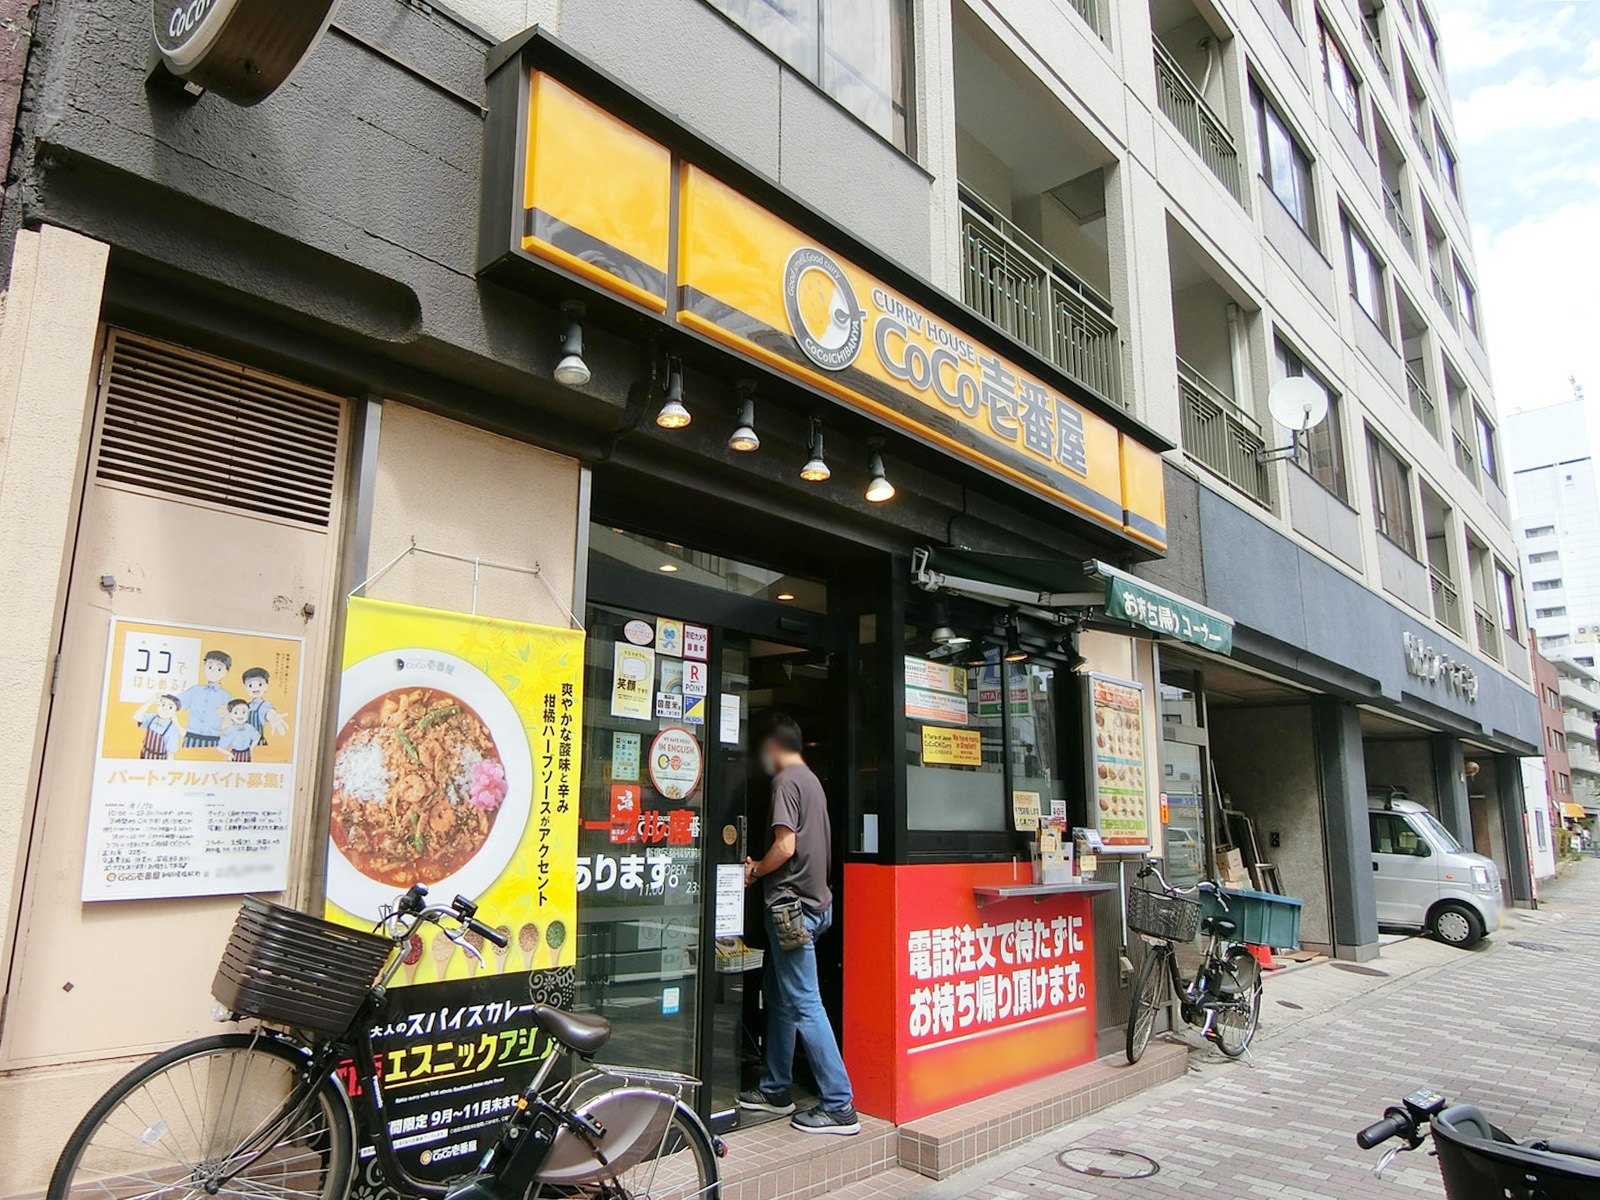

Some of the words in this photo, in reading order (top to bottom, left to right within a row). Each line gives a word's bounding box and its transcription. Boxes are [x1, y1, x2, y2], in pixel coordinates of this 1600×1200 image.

[169, 0, 210, 37] CoCo
[787, 267, 797, 297] Good
[806, 252, 824, 266] Good
[872, 288, 923, 333] CURRY
[926, 320, 976, 363] HOUSE
[874, 316, 1089, 478] CoCo壱番屋
[1122, 591, 1223, 642] お持ち帰りコーナー
[617, 677, 636, 692] 笑顔
[685, 683, 704, 693] POINT
[690, 665, 699, 680] R
[556, 682, 574, 814] 爽やかな酸味と辛み
[667, 744, 695, 754] ENGLISH
[537, 693, 556, 907] 柑橘ハーブソースがアクセント
[664, 864, 688, 876] OPEN
[908, 915, 1084, 980] 電話注文で待たずに
[370, 1000, 535, 1038] 大人のスパイスカレー
[908, 960, 1086, 1037] お持ち帰り頂けます。
[388, 1114, 428, 1136] 間限定
